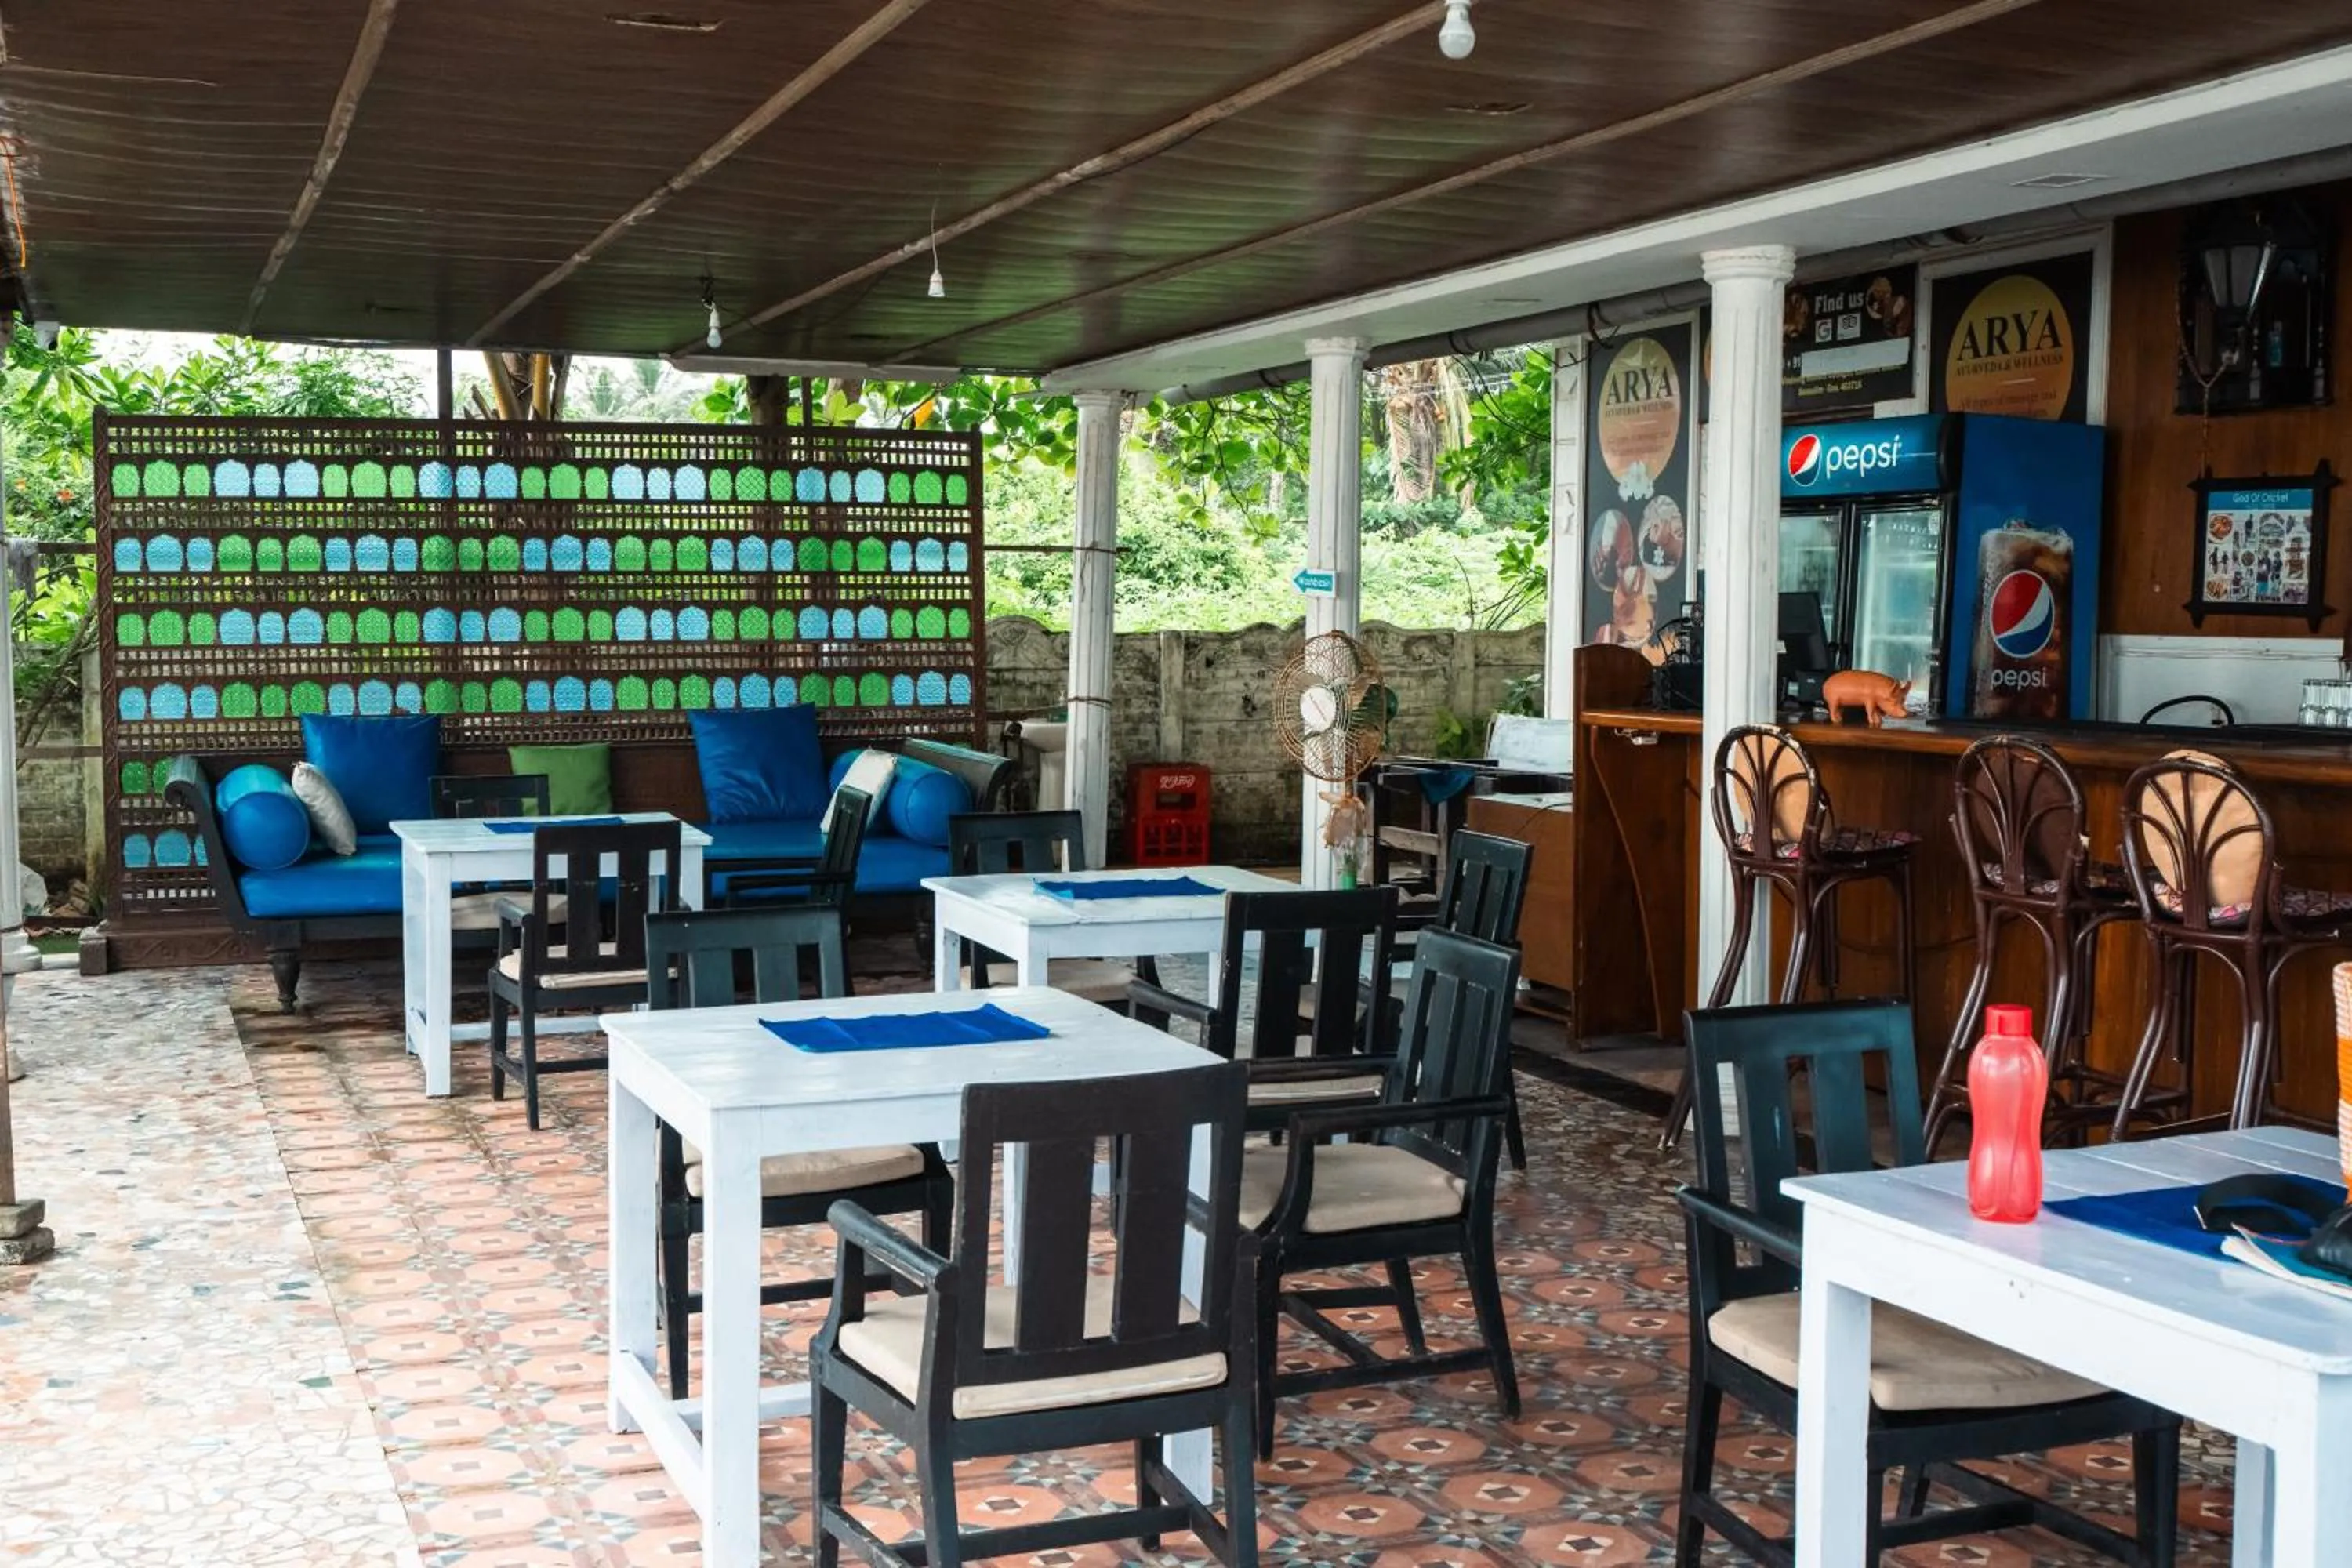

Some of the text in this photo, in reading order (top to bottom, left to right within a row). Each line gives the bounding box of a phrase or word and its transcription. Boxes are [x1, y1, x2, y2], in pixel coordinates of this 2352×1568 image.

[1815, 292, 1864, 314] Find us
[1957, 308, 2062, 361] ARYA
[2013, 354, 2064, 369] WELLNESS
[1606, 365, 1674, 405] ARYA
[1826, 434, 1900, 480] pepsi
[2232, 492, 2249, 503] God
[1990, 666, 2046, 691] pepsi
